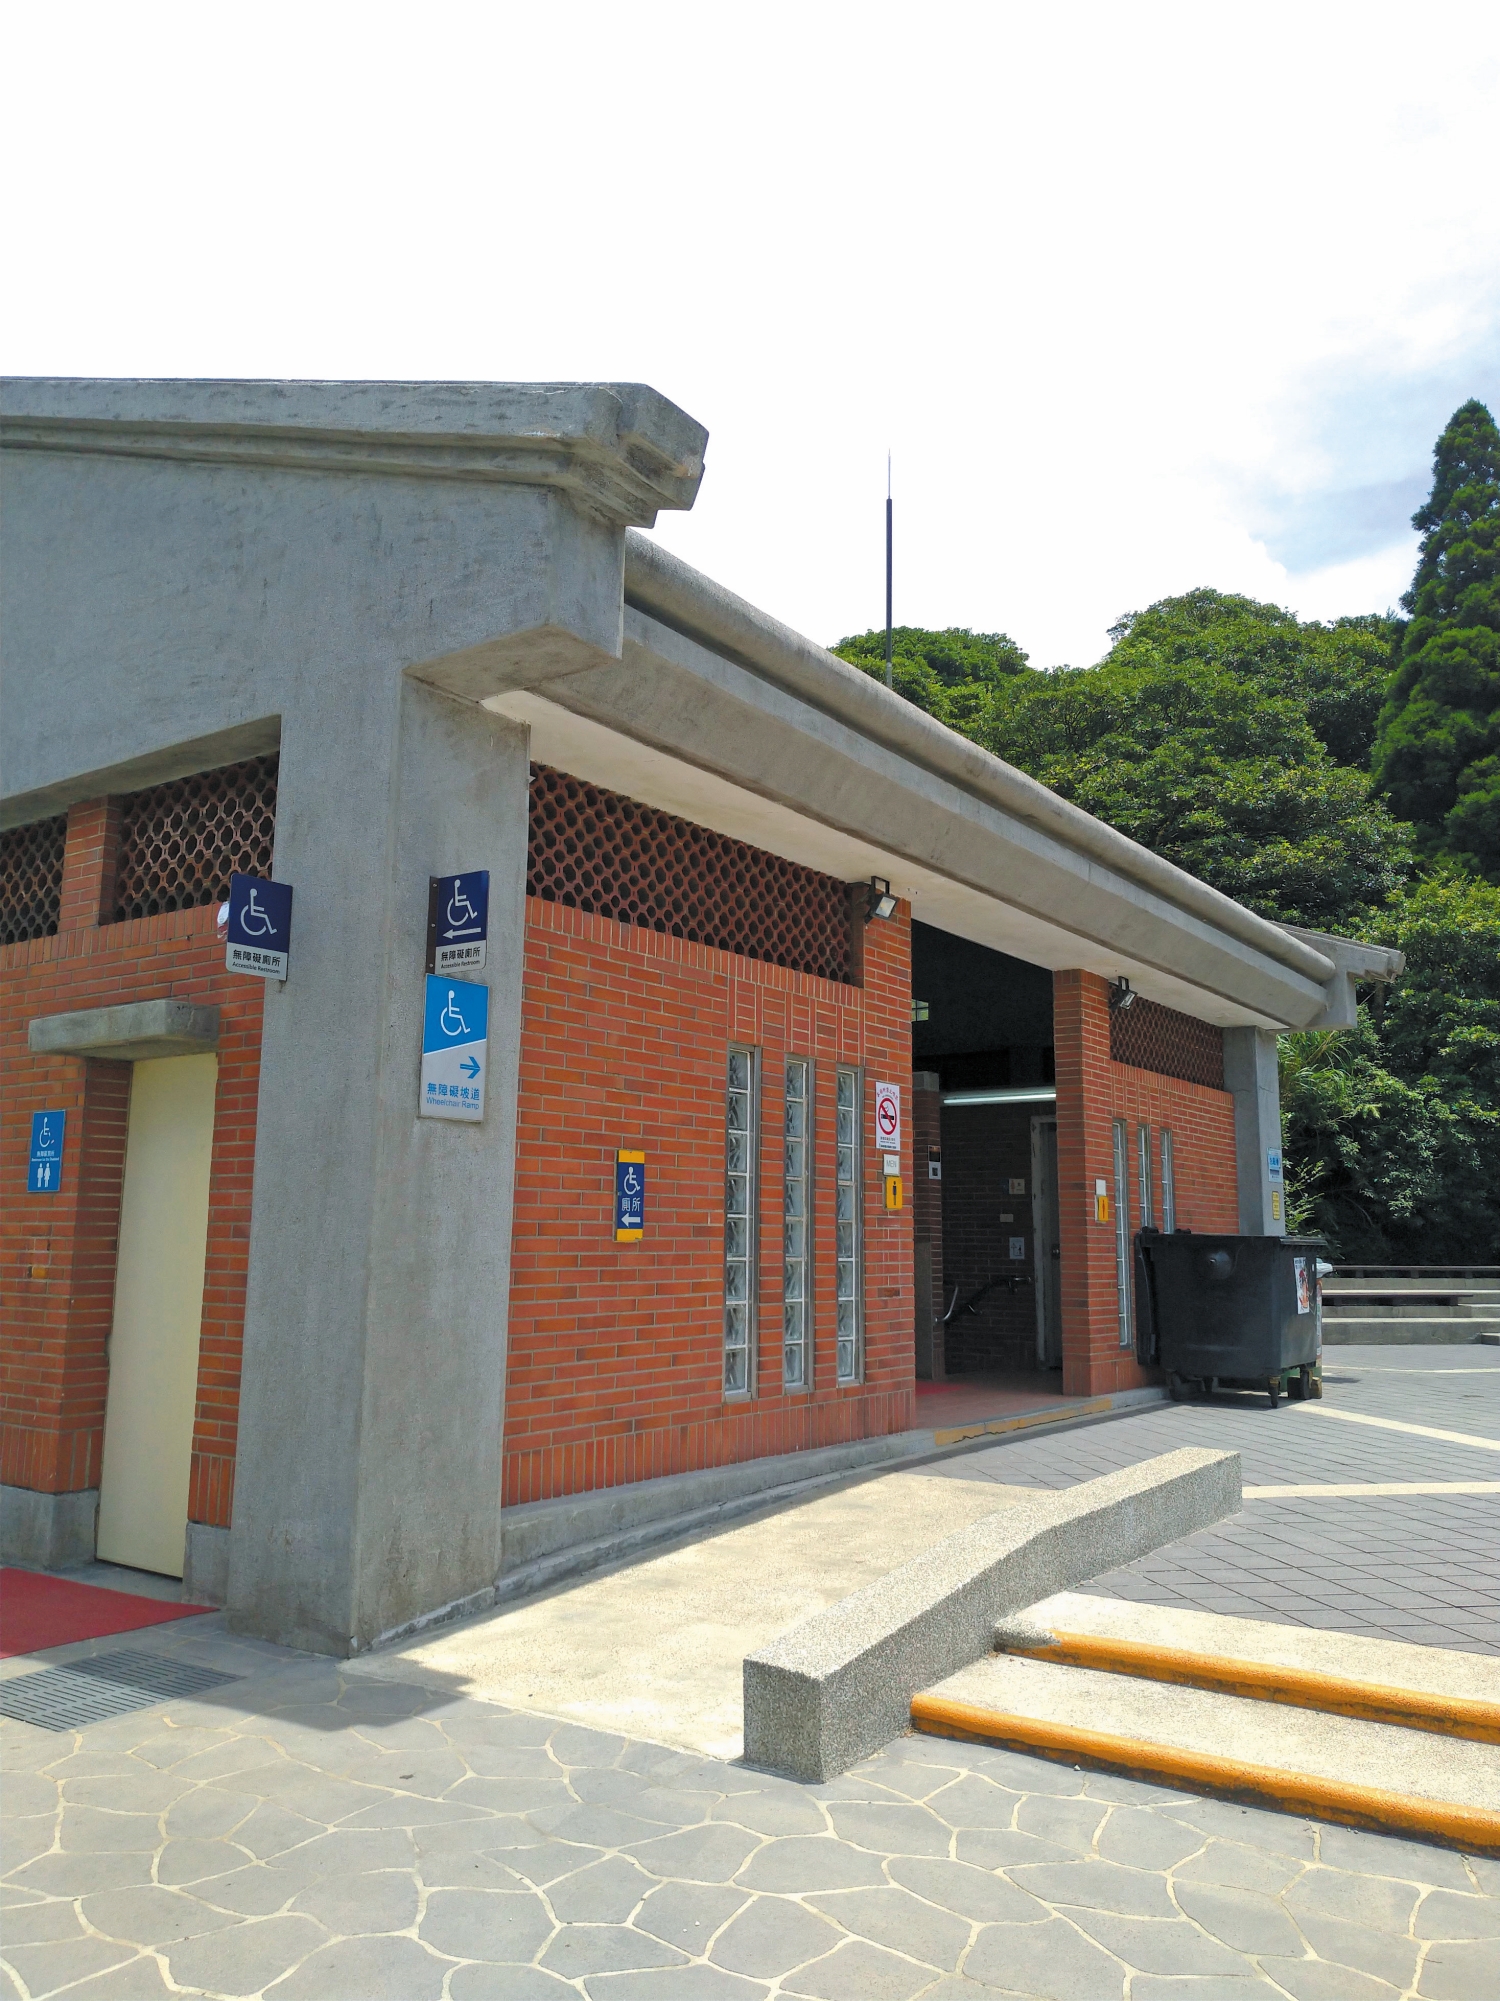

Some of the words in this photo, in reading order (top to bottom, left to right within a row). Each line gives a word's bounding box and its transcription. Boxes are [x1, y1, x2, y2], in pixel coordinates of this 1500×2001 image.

[232, 949, 281, 967] 無障礙廁所
[441, 946, 481, 961] 無障礙廁所
[232, 961, 257, 971] Accessible
[257, 965, 280, 975] Restroom
[441, 961, 460, 969] Accessible
[427, 1082, 480, 1101] 無障礙坡道
[426, 1096, 461, 1107] Wheelchair
[461, 1100, 480, 1110] Ramp
[886, 1159, 897, 1168] MEN
[621, 1197, 641, 1212] 廁所
